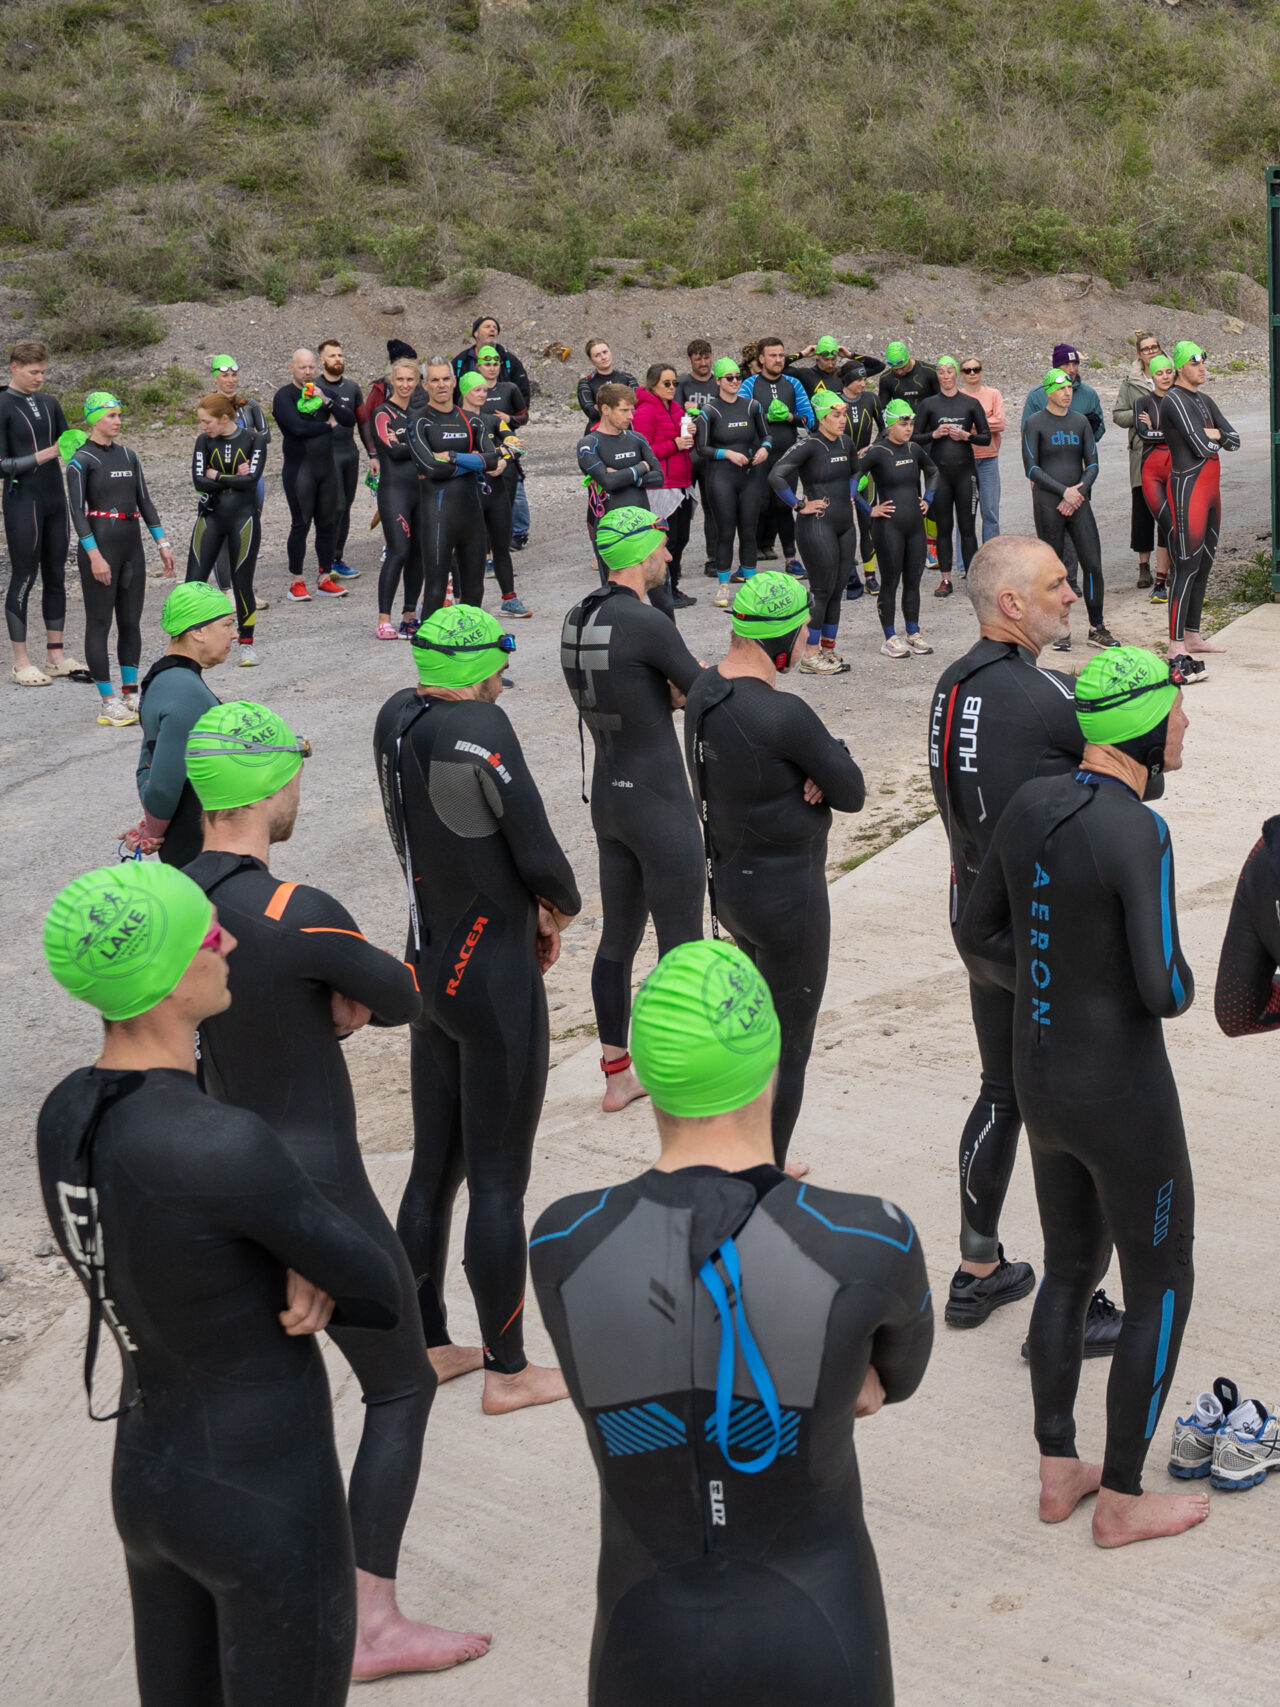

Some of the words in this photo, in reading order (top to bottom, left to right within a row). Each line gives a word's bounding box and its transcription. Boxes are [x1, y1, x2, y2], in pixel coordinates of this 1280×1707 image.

[769, 383, 779, 399] HUU
[1050, 430, 1080, 446] dhb
[196, 451, 204, 476] HUUB
[626, 514, 645, 531] LAKE
[767, 596, 792, 614] LAKE
[930, 693, 947, 768] HUUB
[959, 696, 982, 773] HUUB
[454, 739, 513, 785] IRONMAN
[617, 780, 634, 789] dhb
[101, 909, 147, 960] LAKE
[446, 916, 489, 997] RACER
[1030, 861, 1051, 1026] AERON
[739, 985, 766, 1031] LAKE
